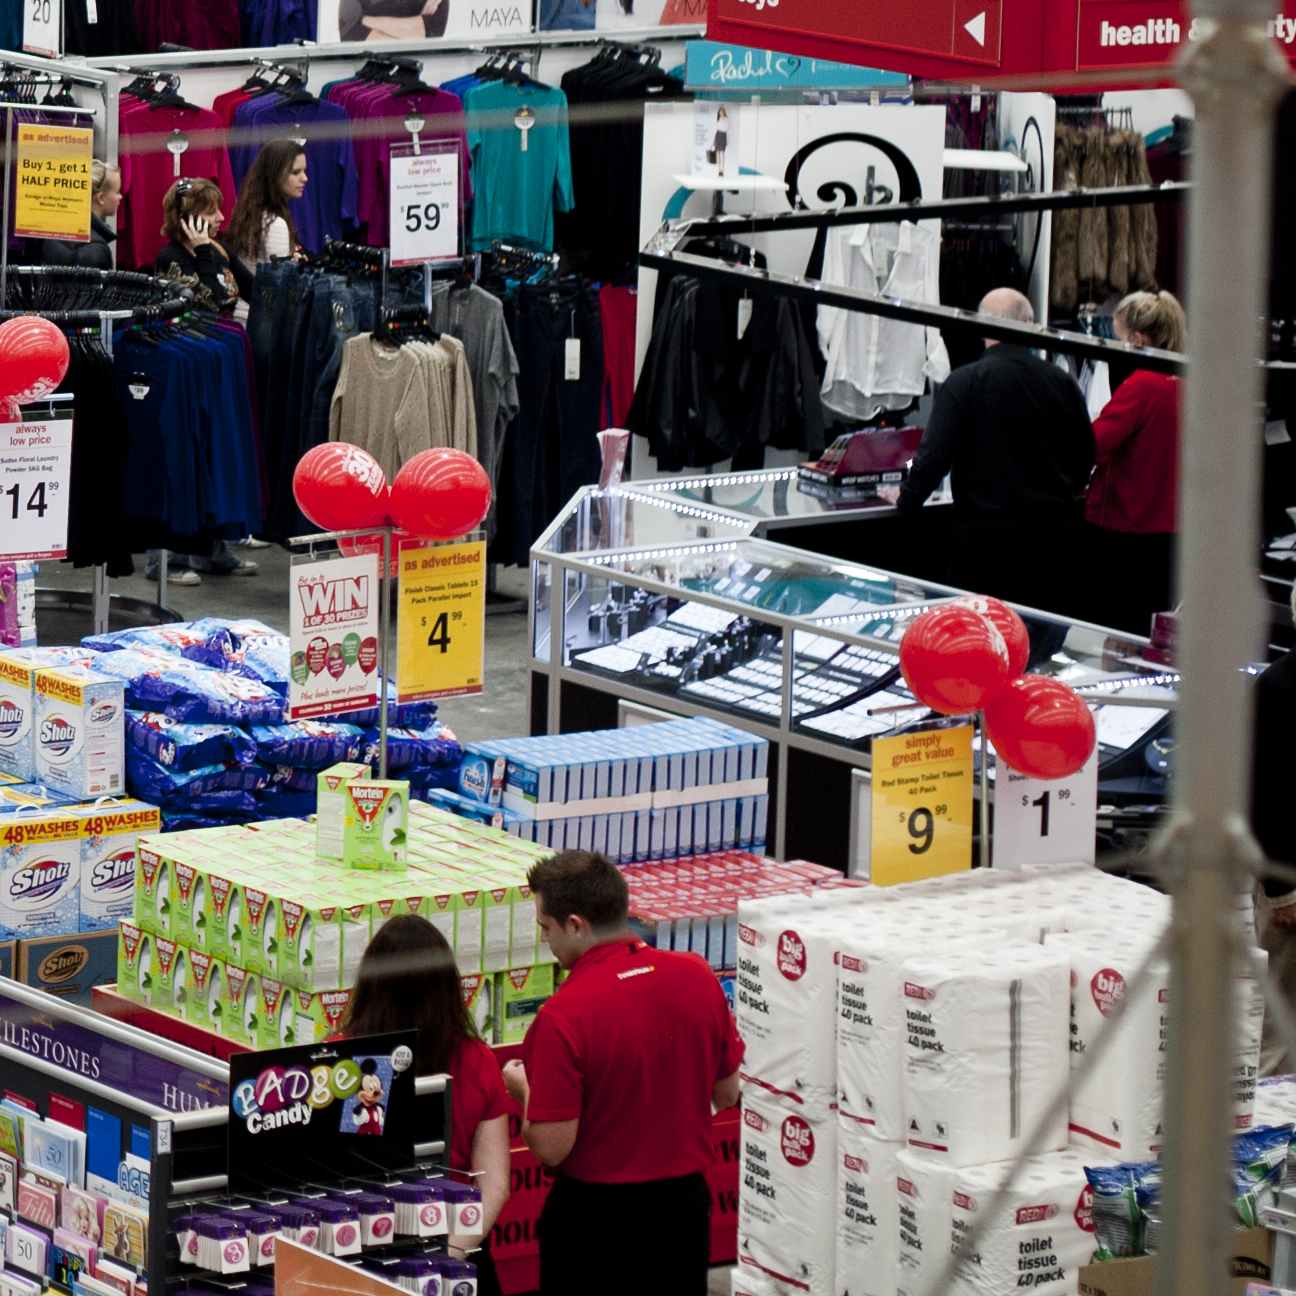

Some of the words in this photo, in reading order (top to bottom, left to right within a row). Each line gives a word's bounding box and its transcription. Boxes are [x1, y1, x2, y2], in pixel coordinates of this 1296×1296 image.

[471, 7, 523, 29] MAYA
[1101, 19, 1180, 47] health
[16, 424, 46, 434] always
[298, 575, 368, 616] WIN
[311, 615, 323, 625] OF
[324, 613, 335, 624] 30
[336, 608, 368, 622] PRIZES
[905, 734, 941, 750] simply
[892, 751, 922, 768] great
[926, 747, 954, 759] value
[352, 786, 385, 802] Mortein
[9, 861, 71, 900] Shotz
[842, 982, 864, 1000] toilet
[246, 1102, 313, 1136] Candy
